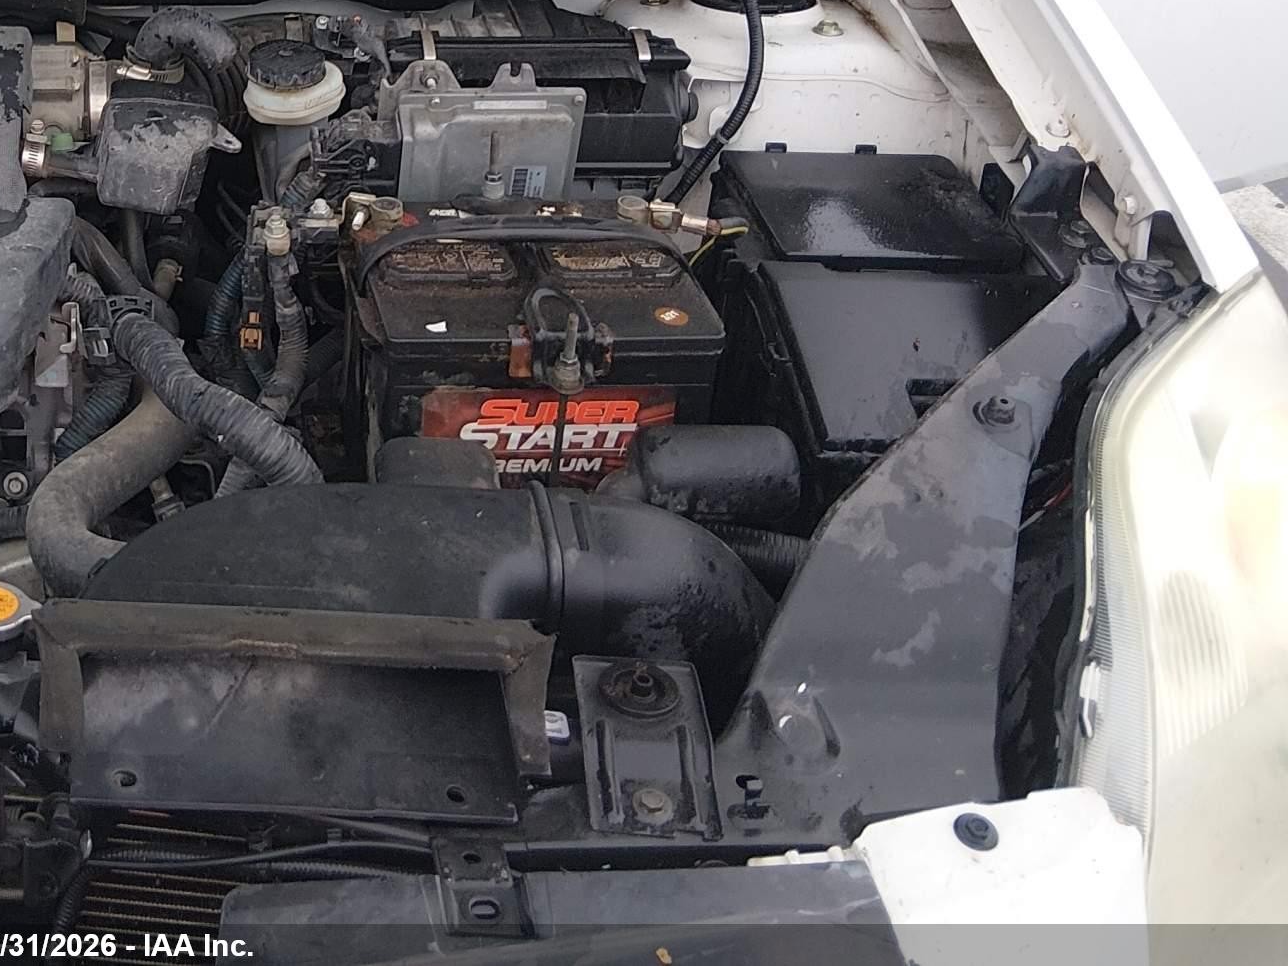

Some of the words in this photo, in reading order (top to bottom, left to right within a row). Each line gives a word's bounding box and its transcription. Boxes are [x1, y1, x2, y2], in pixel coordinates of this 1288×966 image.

[477, 399, 640, 425] SUPER
[460, 422, 638, 450] START
[495, 458, 603, 474] REMUM
